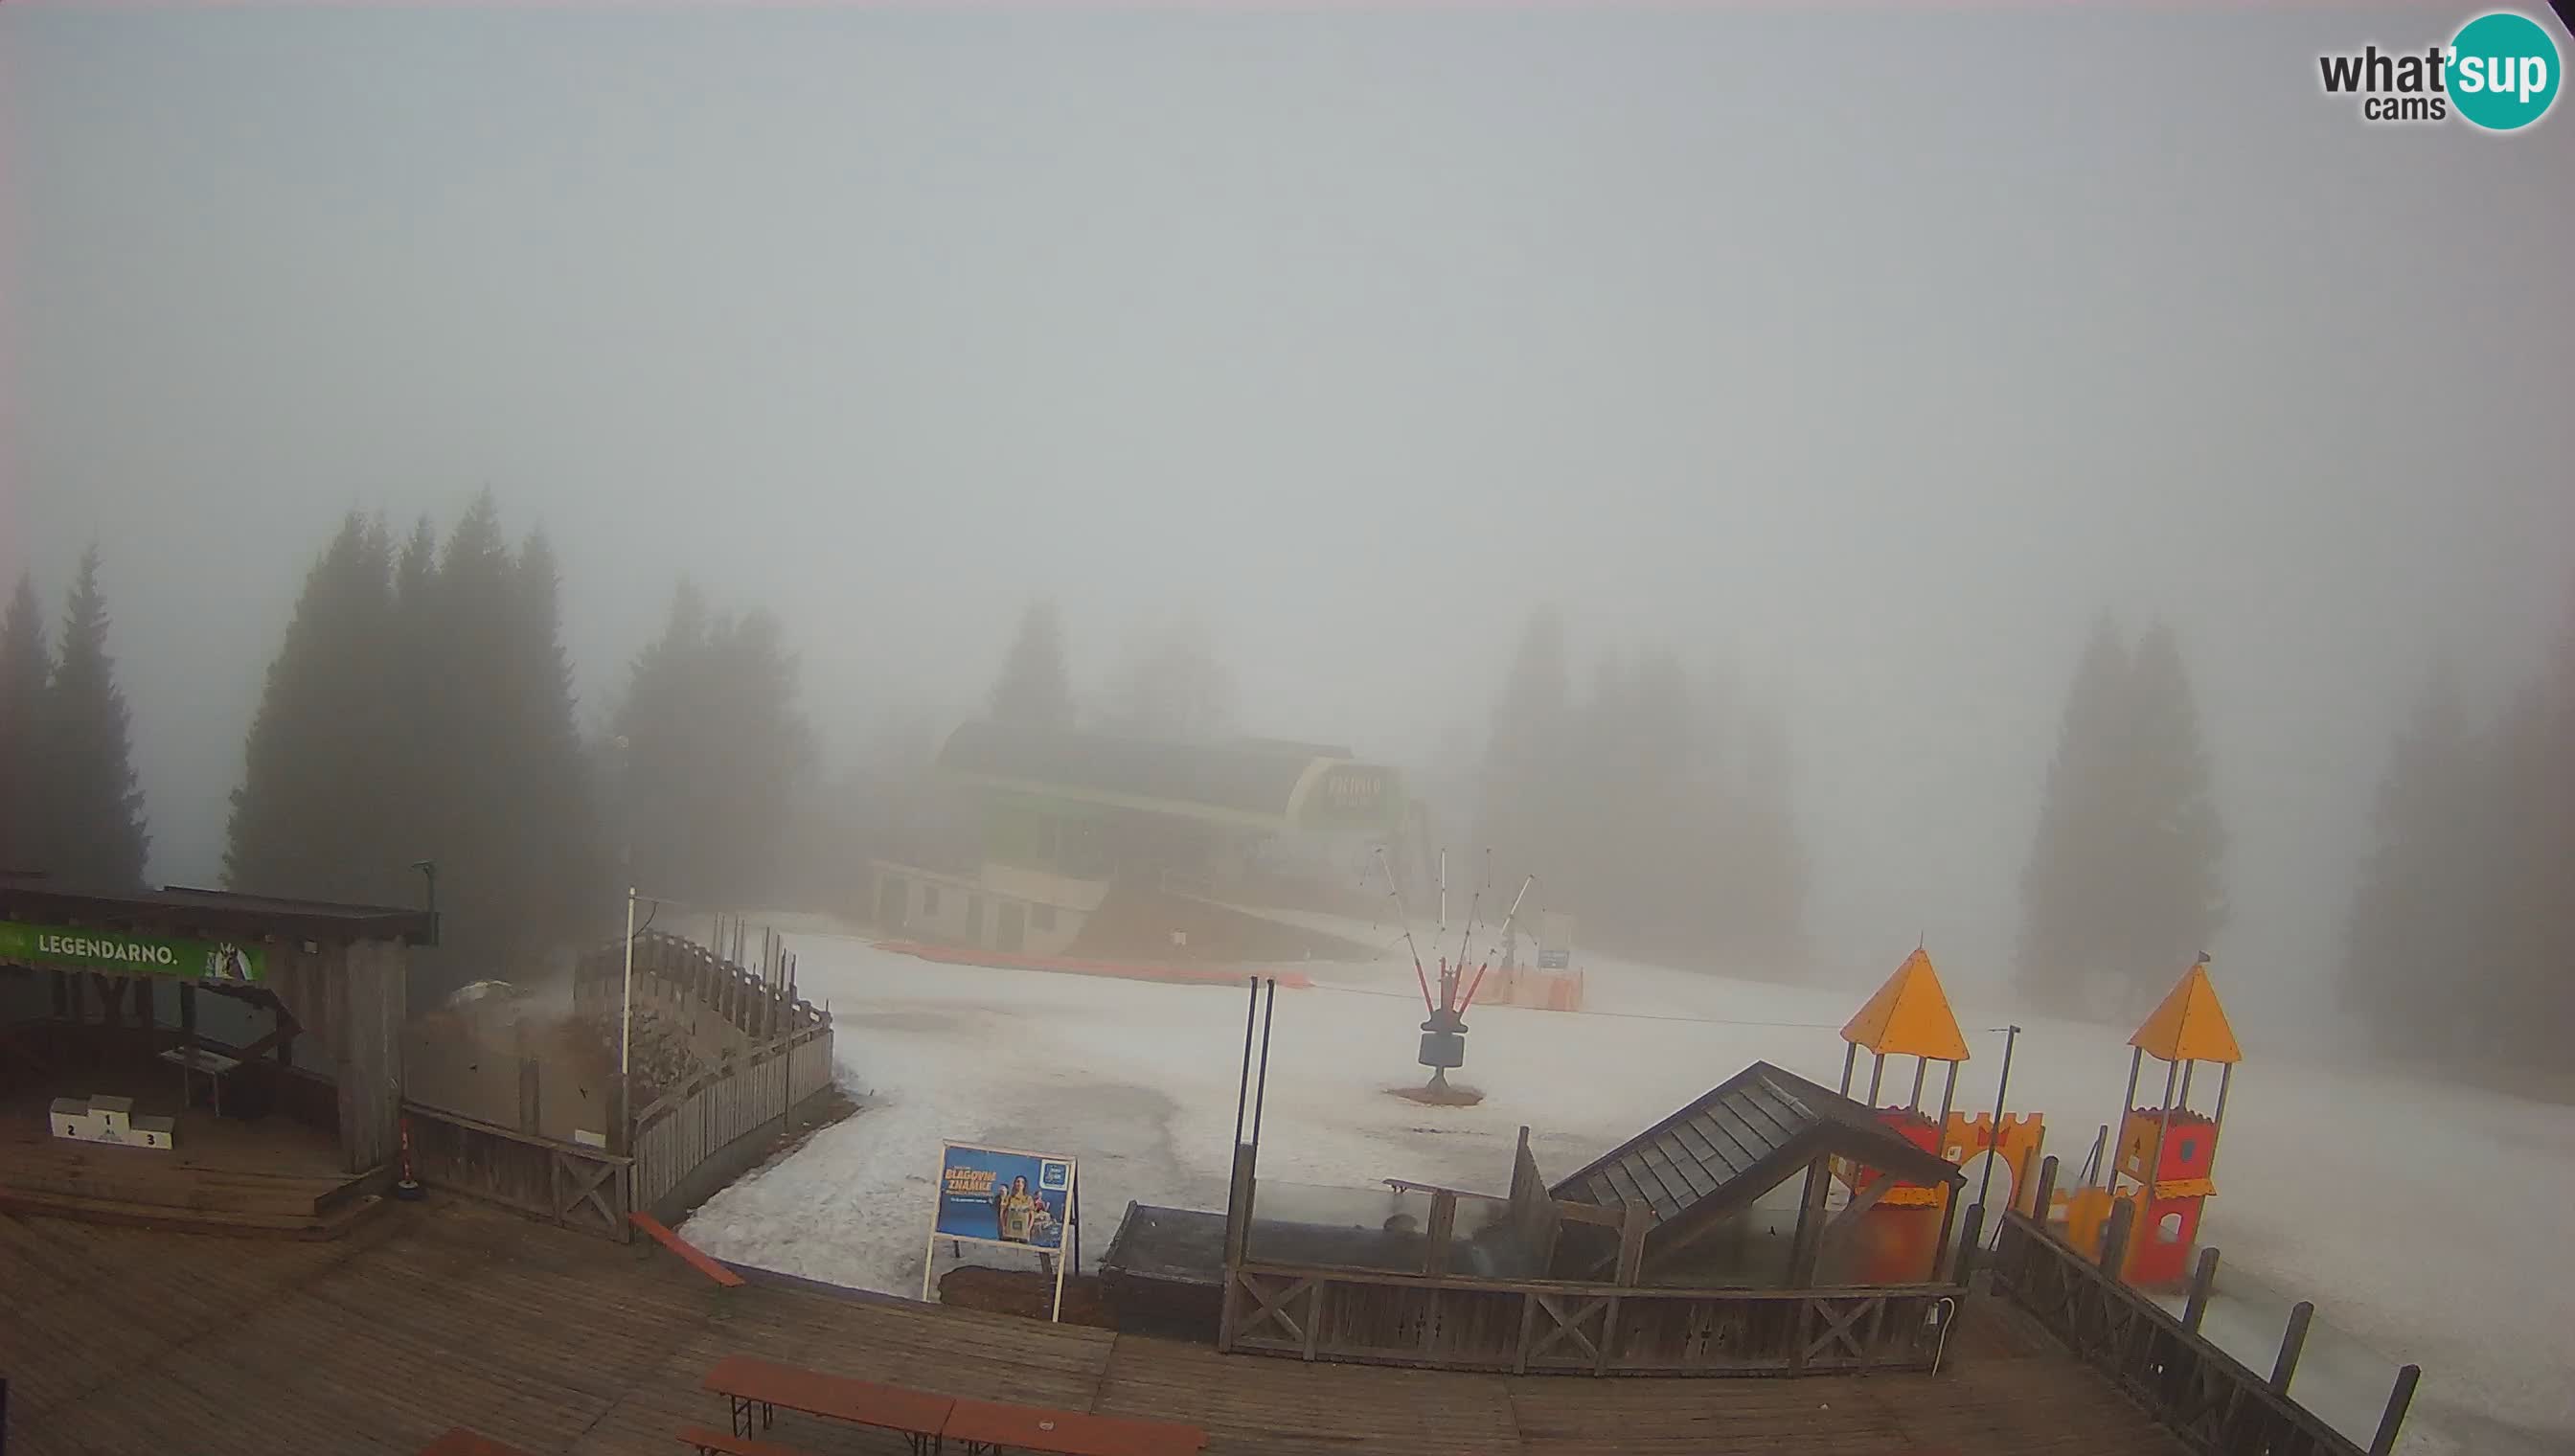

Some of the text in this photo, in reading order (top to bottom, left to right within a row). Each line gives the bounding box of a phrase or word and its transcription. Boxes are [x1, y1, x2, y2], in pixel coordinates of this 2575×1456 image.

[38, 934, 178, 966] LEGENDARNO.
[105, 1114, 111, 1126] 1
[67, 1125, 76, 1136] 2
[147, 1134, 155, 1146] 3
